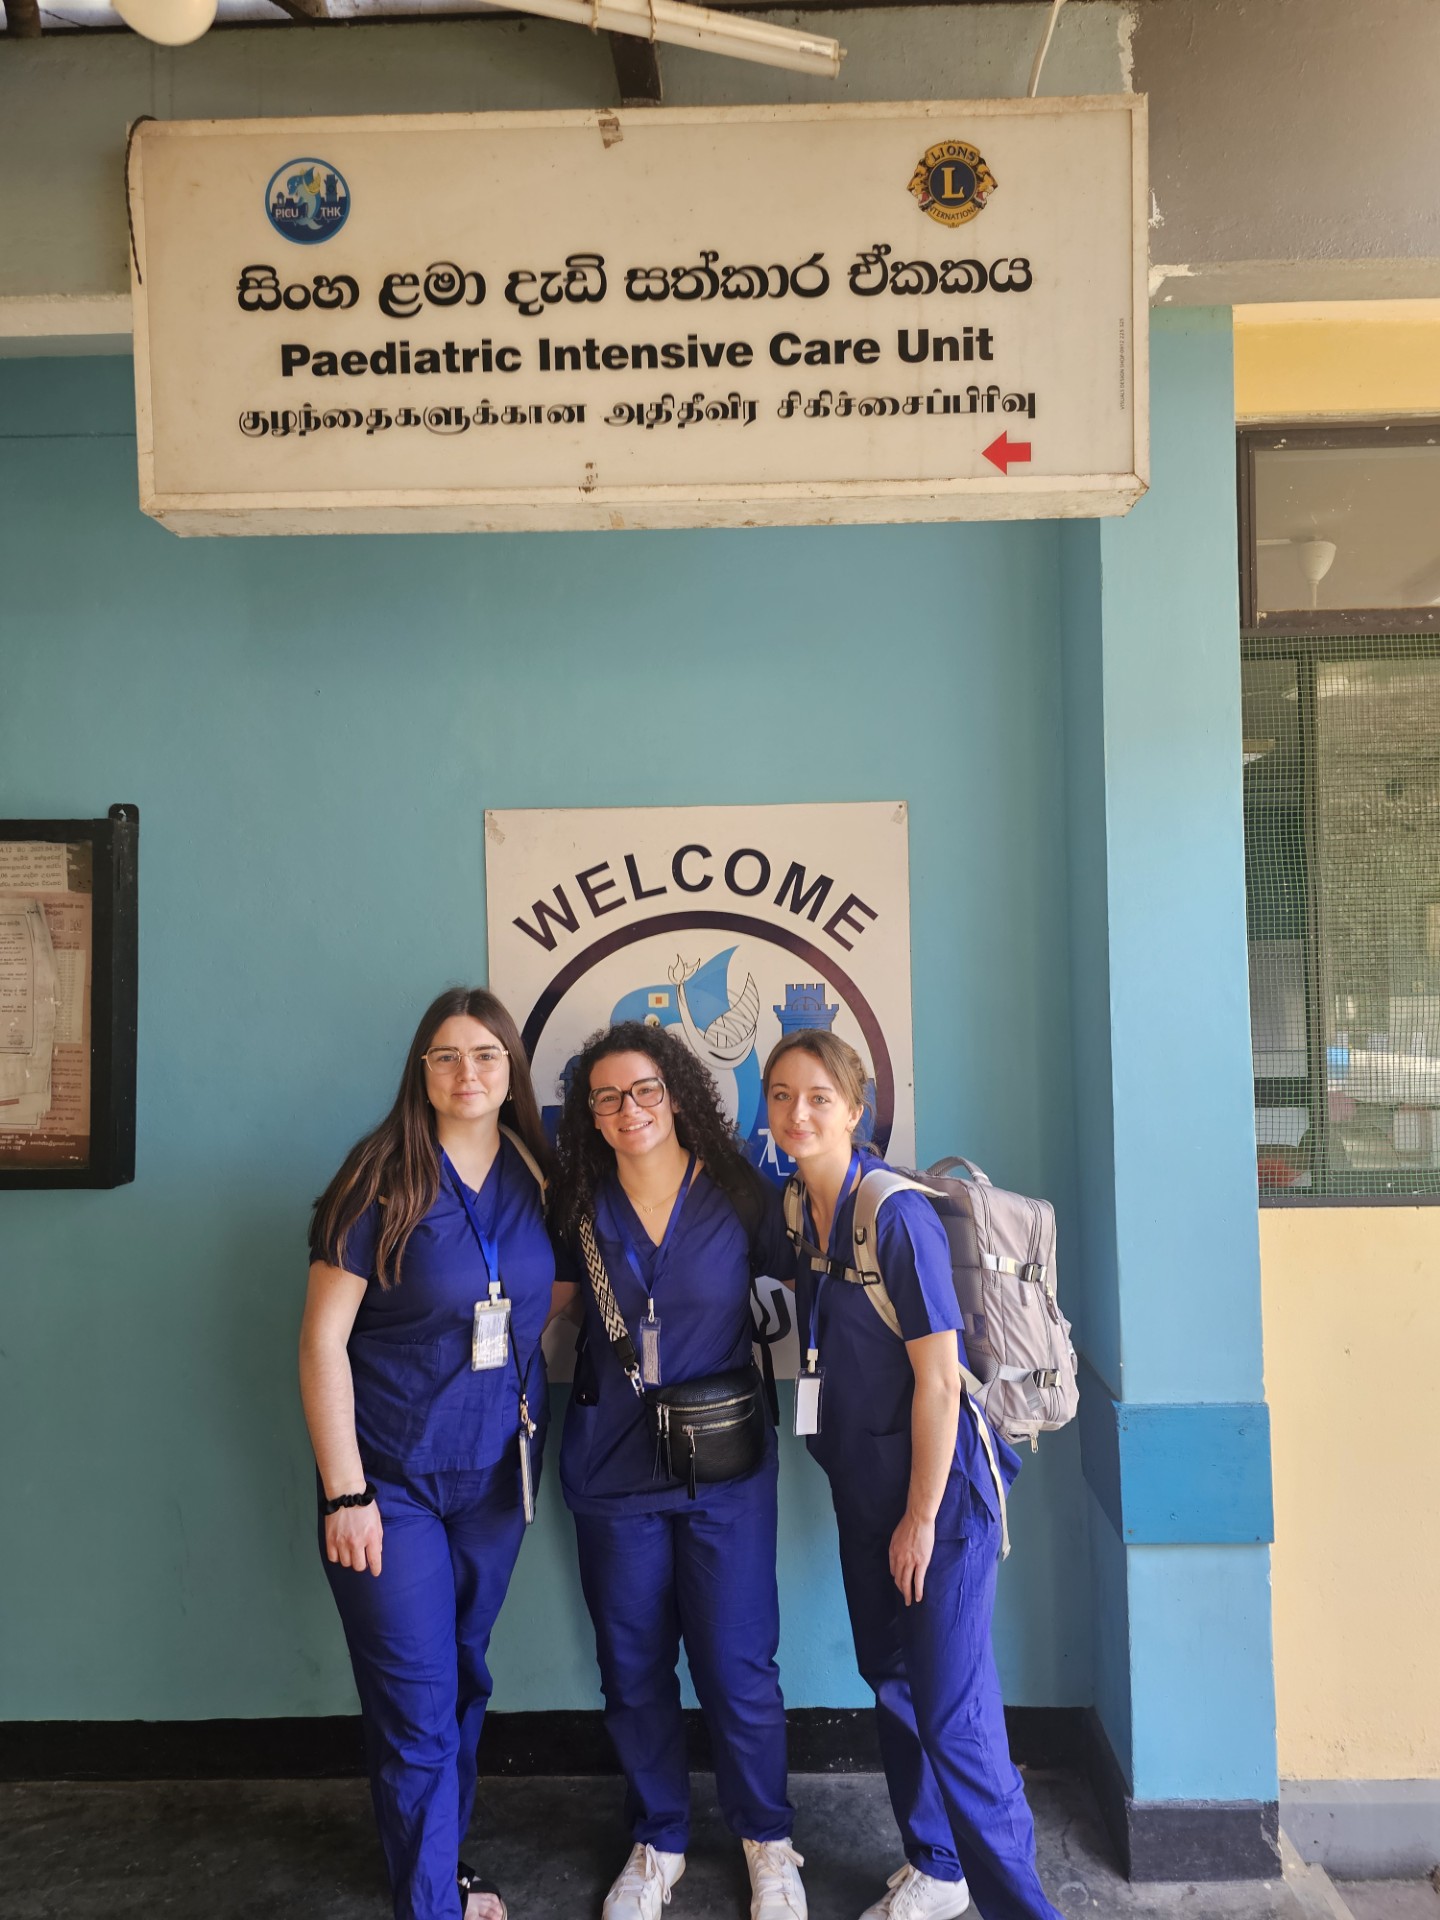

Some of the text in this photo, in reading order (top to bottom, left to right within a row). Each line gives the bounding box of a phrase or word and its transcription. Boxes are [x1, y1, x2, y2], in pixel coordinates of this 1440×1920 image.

[931, 145, 977, 161] LIONS
[941, 167, 965, 199] L
[275, 208, 299, 218] PICU
[320, 206, 342, 217] THK
[236, 244, 1033, 319] සිංහ ළමා දැඩි සත්කාර ඒකකය
[280, 327, 994, 377] Paediatric Intensive Care Unit
[239, 385, 1036, 437] குழந்தைகளுக்கான அதிதீவிர சிகிச்சைப்பிரிவு
[512, 844, 879, 952] WELCOME
